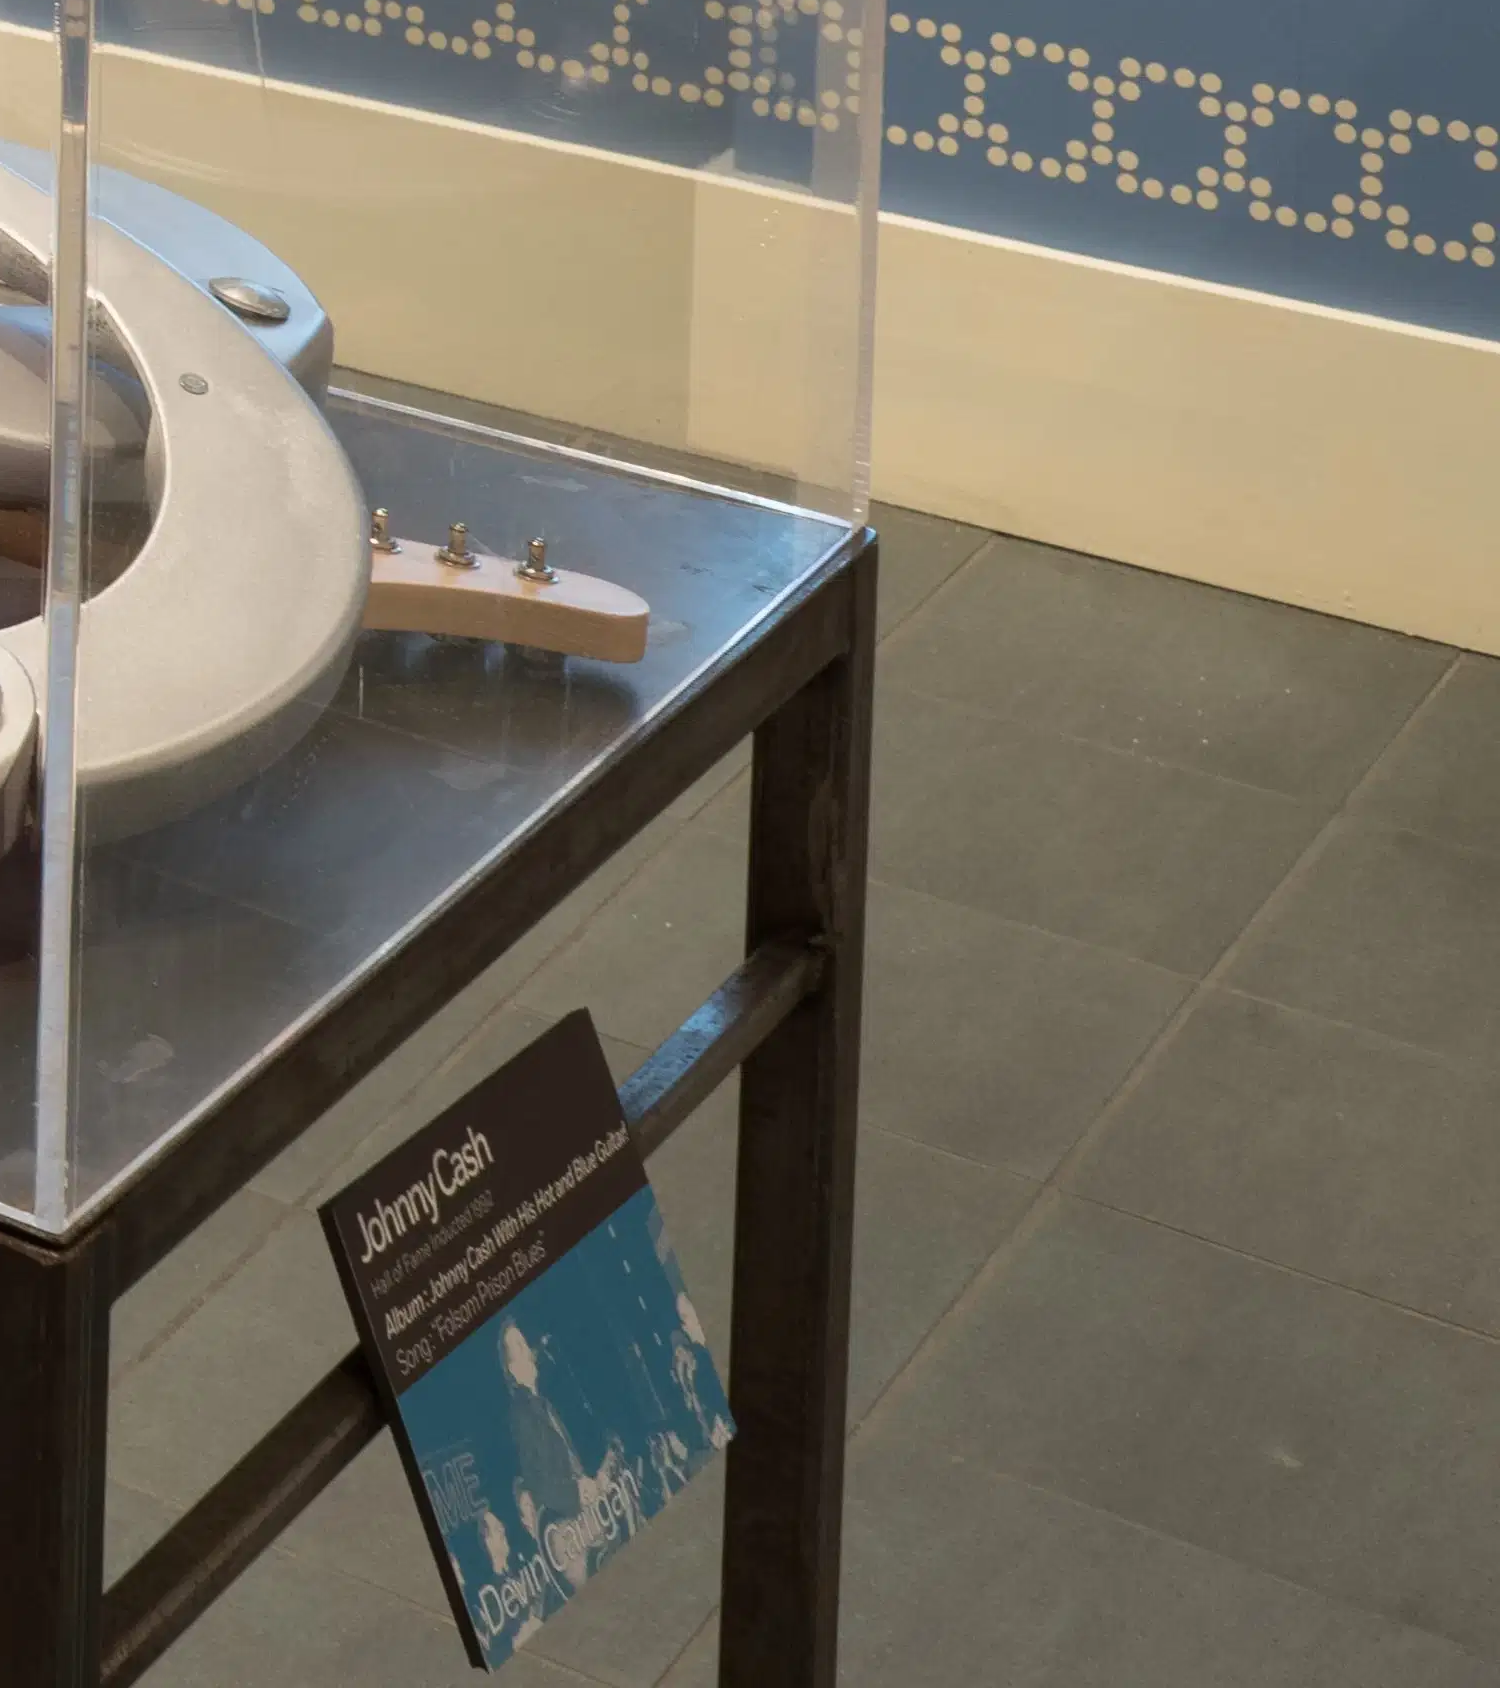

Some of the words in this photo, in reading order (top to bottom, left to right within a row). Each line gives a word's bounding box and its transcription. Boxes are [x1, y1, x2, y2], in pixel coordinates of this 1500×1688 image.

[357, 1172, 438, 1263] Johnny
[432, 1126, 493, 1195] Cash
[385, 1290, 430, 1339] Album:
[429, 1258, 468, 1303] Johnny
[466, 1234, 495, 1269] Cash
[491, 1214, 519, 1247] With
[516, 1200, 537, 1228] His
[533, 1183, 557, 1213] Hot
[554, 1165, 575, 1198] and
[571, 1152, 597, 1181] Blue
[370, 1269, 393, 1299] Hall
[401, 1242, 431, 1272] Fame
[429, 1205, 472, 1250] Inducted
[395, 1333, 436, 1375] Song:
[475, 1265, 516, 1306] Prison
[479, 1552, 550, 1634] Devin
